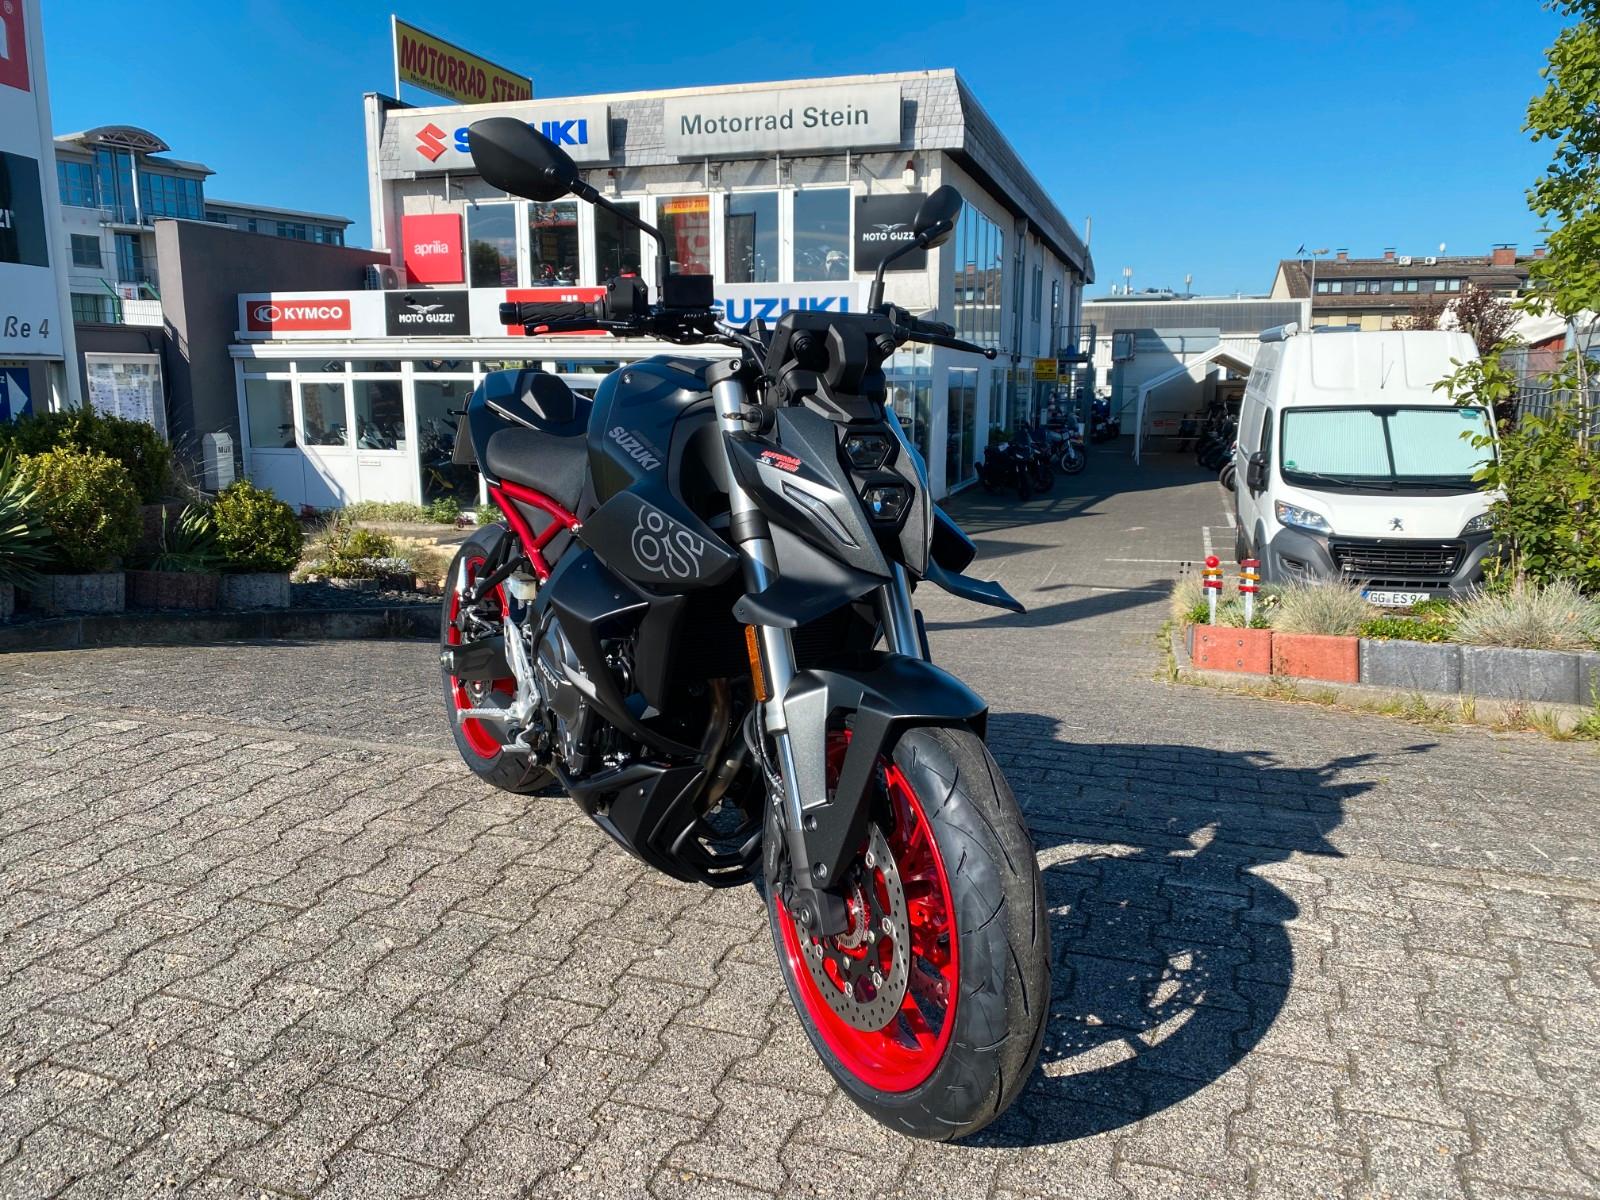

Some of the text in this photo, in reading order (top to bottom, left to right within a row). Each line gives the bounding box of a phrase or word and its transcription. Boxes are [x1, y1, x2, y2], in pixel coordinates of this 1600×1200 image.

[400, 34, 530, 102] MOTORRAD STEIN
[681, 104, 869, 136] Motorrad Stein
[453, 119, 588, 153] SKI
[862, 231, 916, 241] MOTO GUZZ
[413, 240, 449, 256] aprilia
[284, 306, 343, 320] KYMCO
[398, 313, 453, 323] MOTO GUZZI
[38, 318, 49, 339] 4
[608, 426, 663, 471] SUZUKI
[1370, 593, 1385, 603] GG
[1393, 594, 1408, 604] ES
